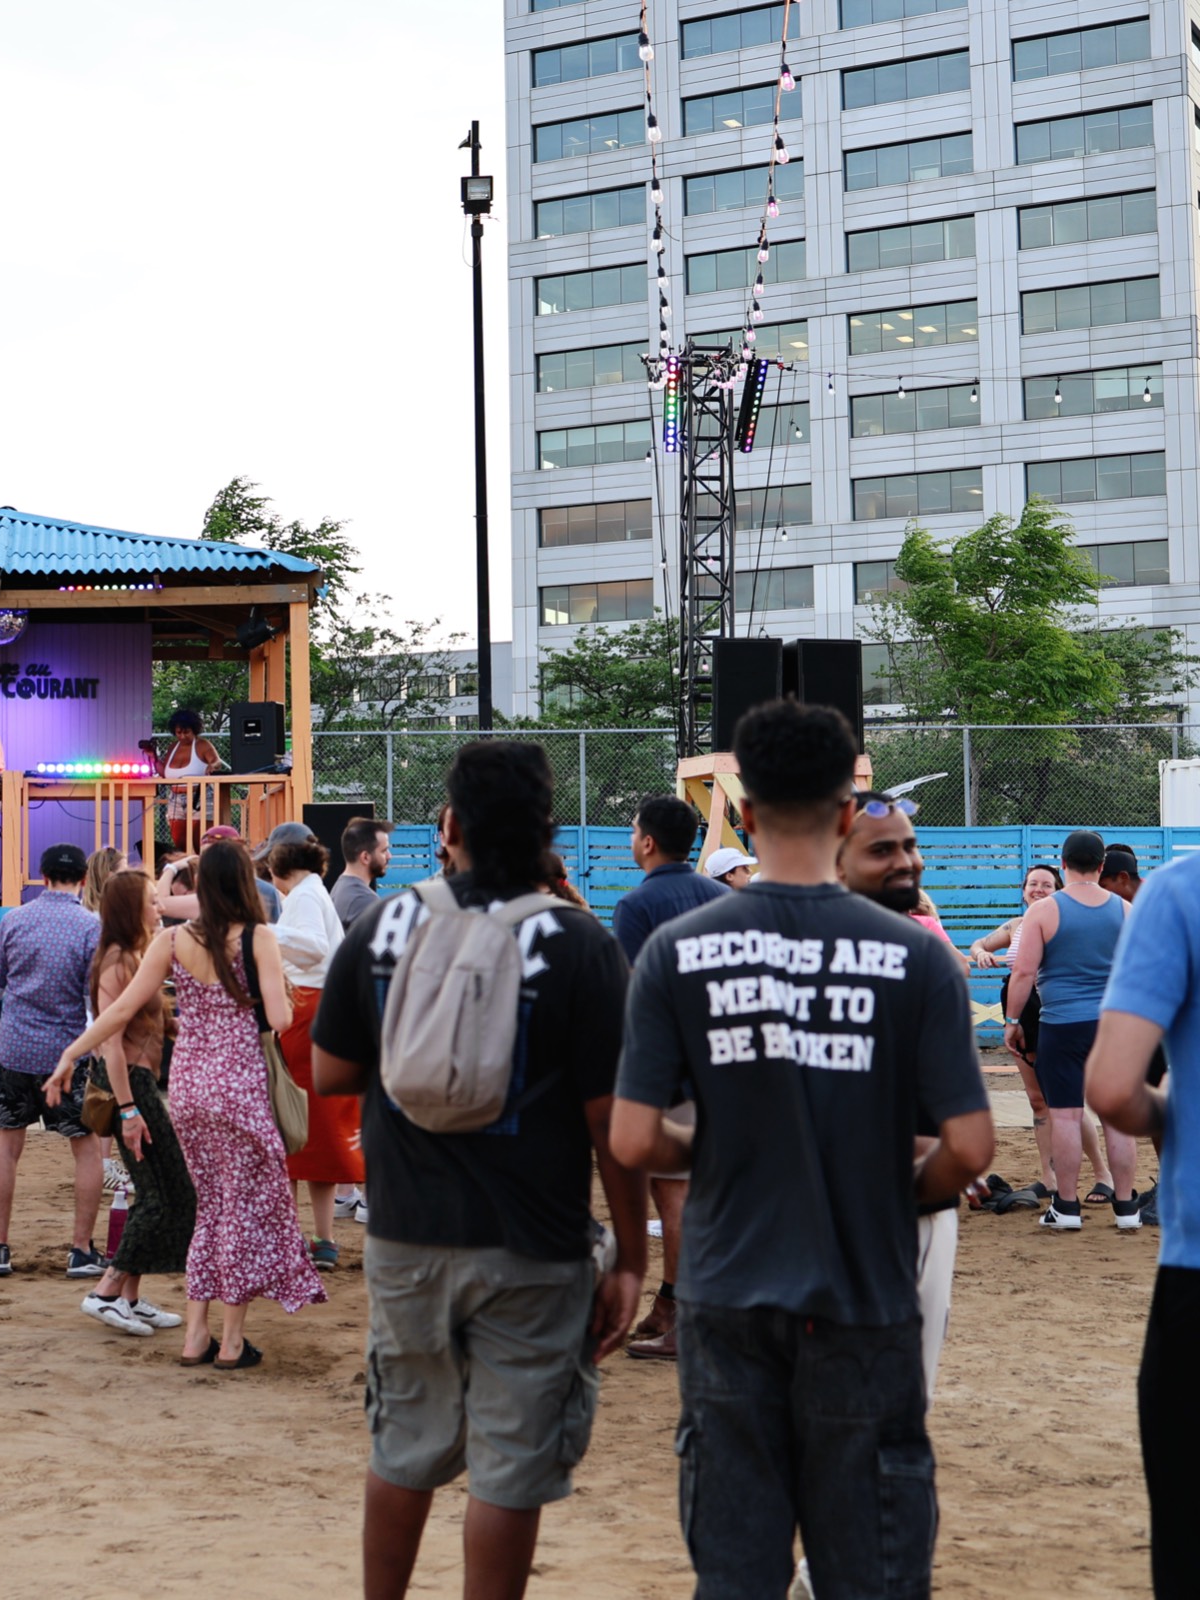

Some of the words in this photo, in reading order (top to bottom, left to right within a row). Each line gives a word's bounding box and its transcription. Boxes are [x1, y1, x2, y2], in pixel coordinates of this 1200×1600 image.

[1, 677, 99, 700] COURANT
[25, 662, 52, 677] au
[675, 929, 824, 975] RECORDS
[829, 938, 908, 980] ARE
[706, 974, 817, 1022] MEANT
[824, 985, 875, 1024] TO
[706, 1026, 757, 1065] BE
